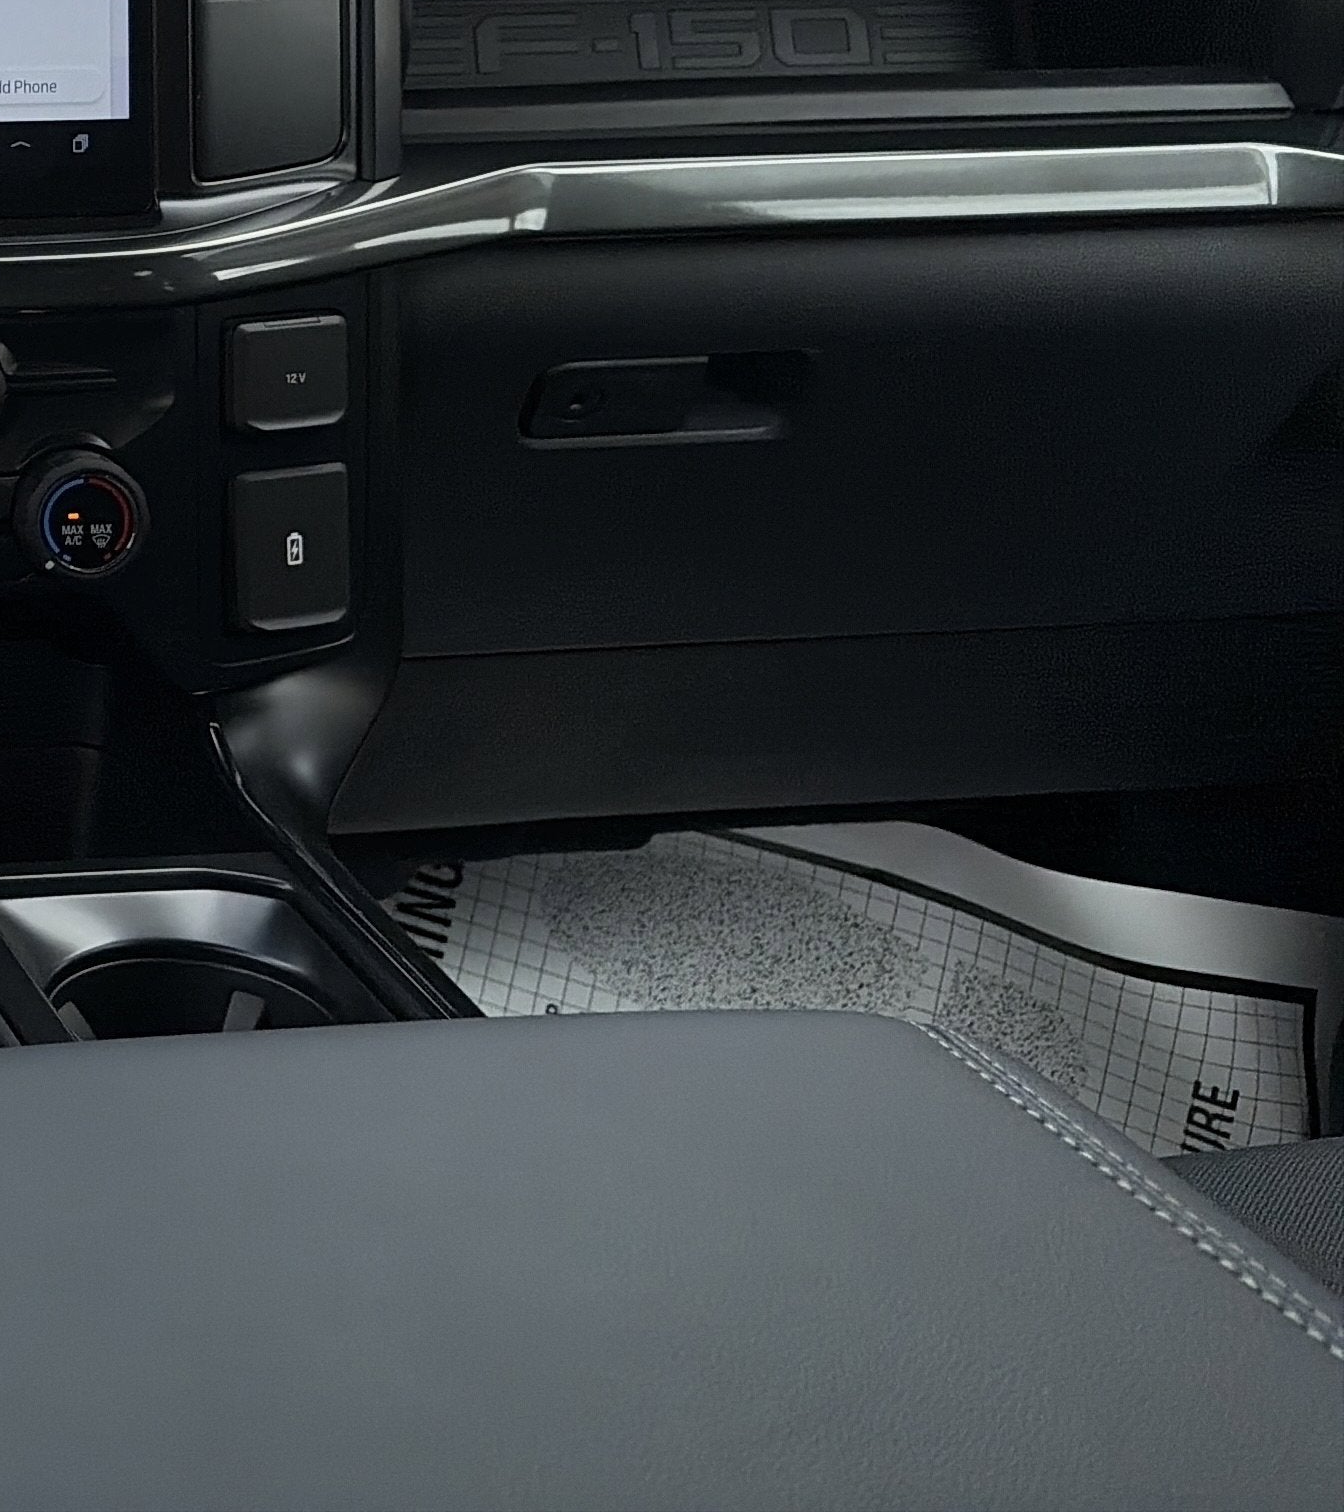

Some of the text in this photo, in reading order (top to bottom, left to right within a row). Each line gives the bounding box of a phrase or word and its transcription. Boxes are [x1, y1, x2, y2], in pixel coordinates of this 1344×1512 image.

[472, 5, 873, 77] F-150
[14, 79, 57, 95] Phone
[61, 525, 84, 536] MAX
[90, 523, 113, 535] MAX
[64, 535, 83, 546] A/C
